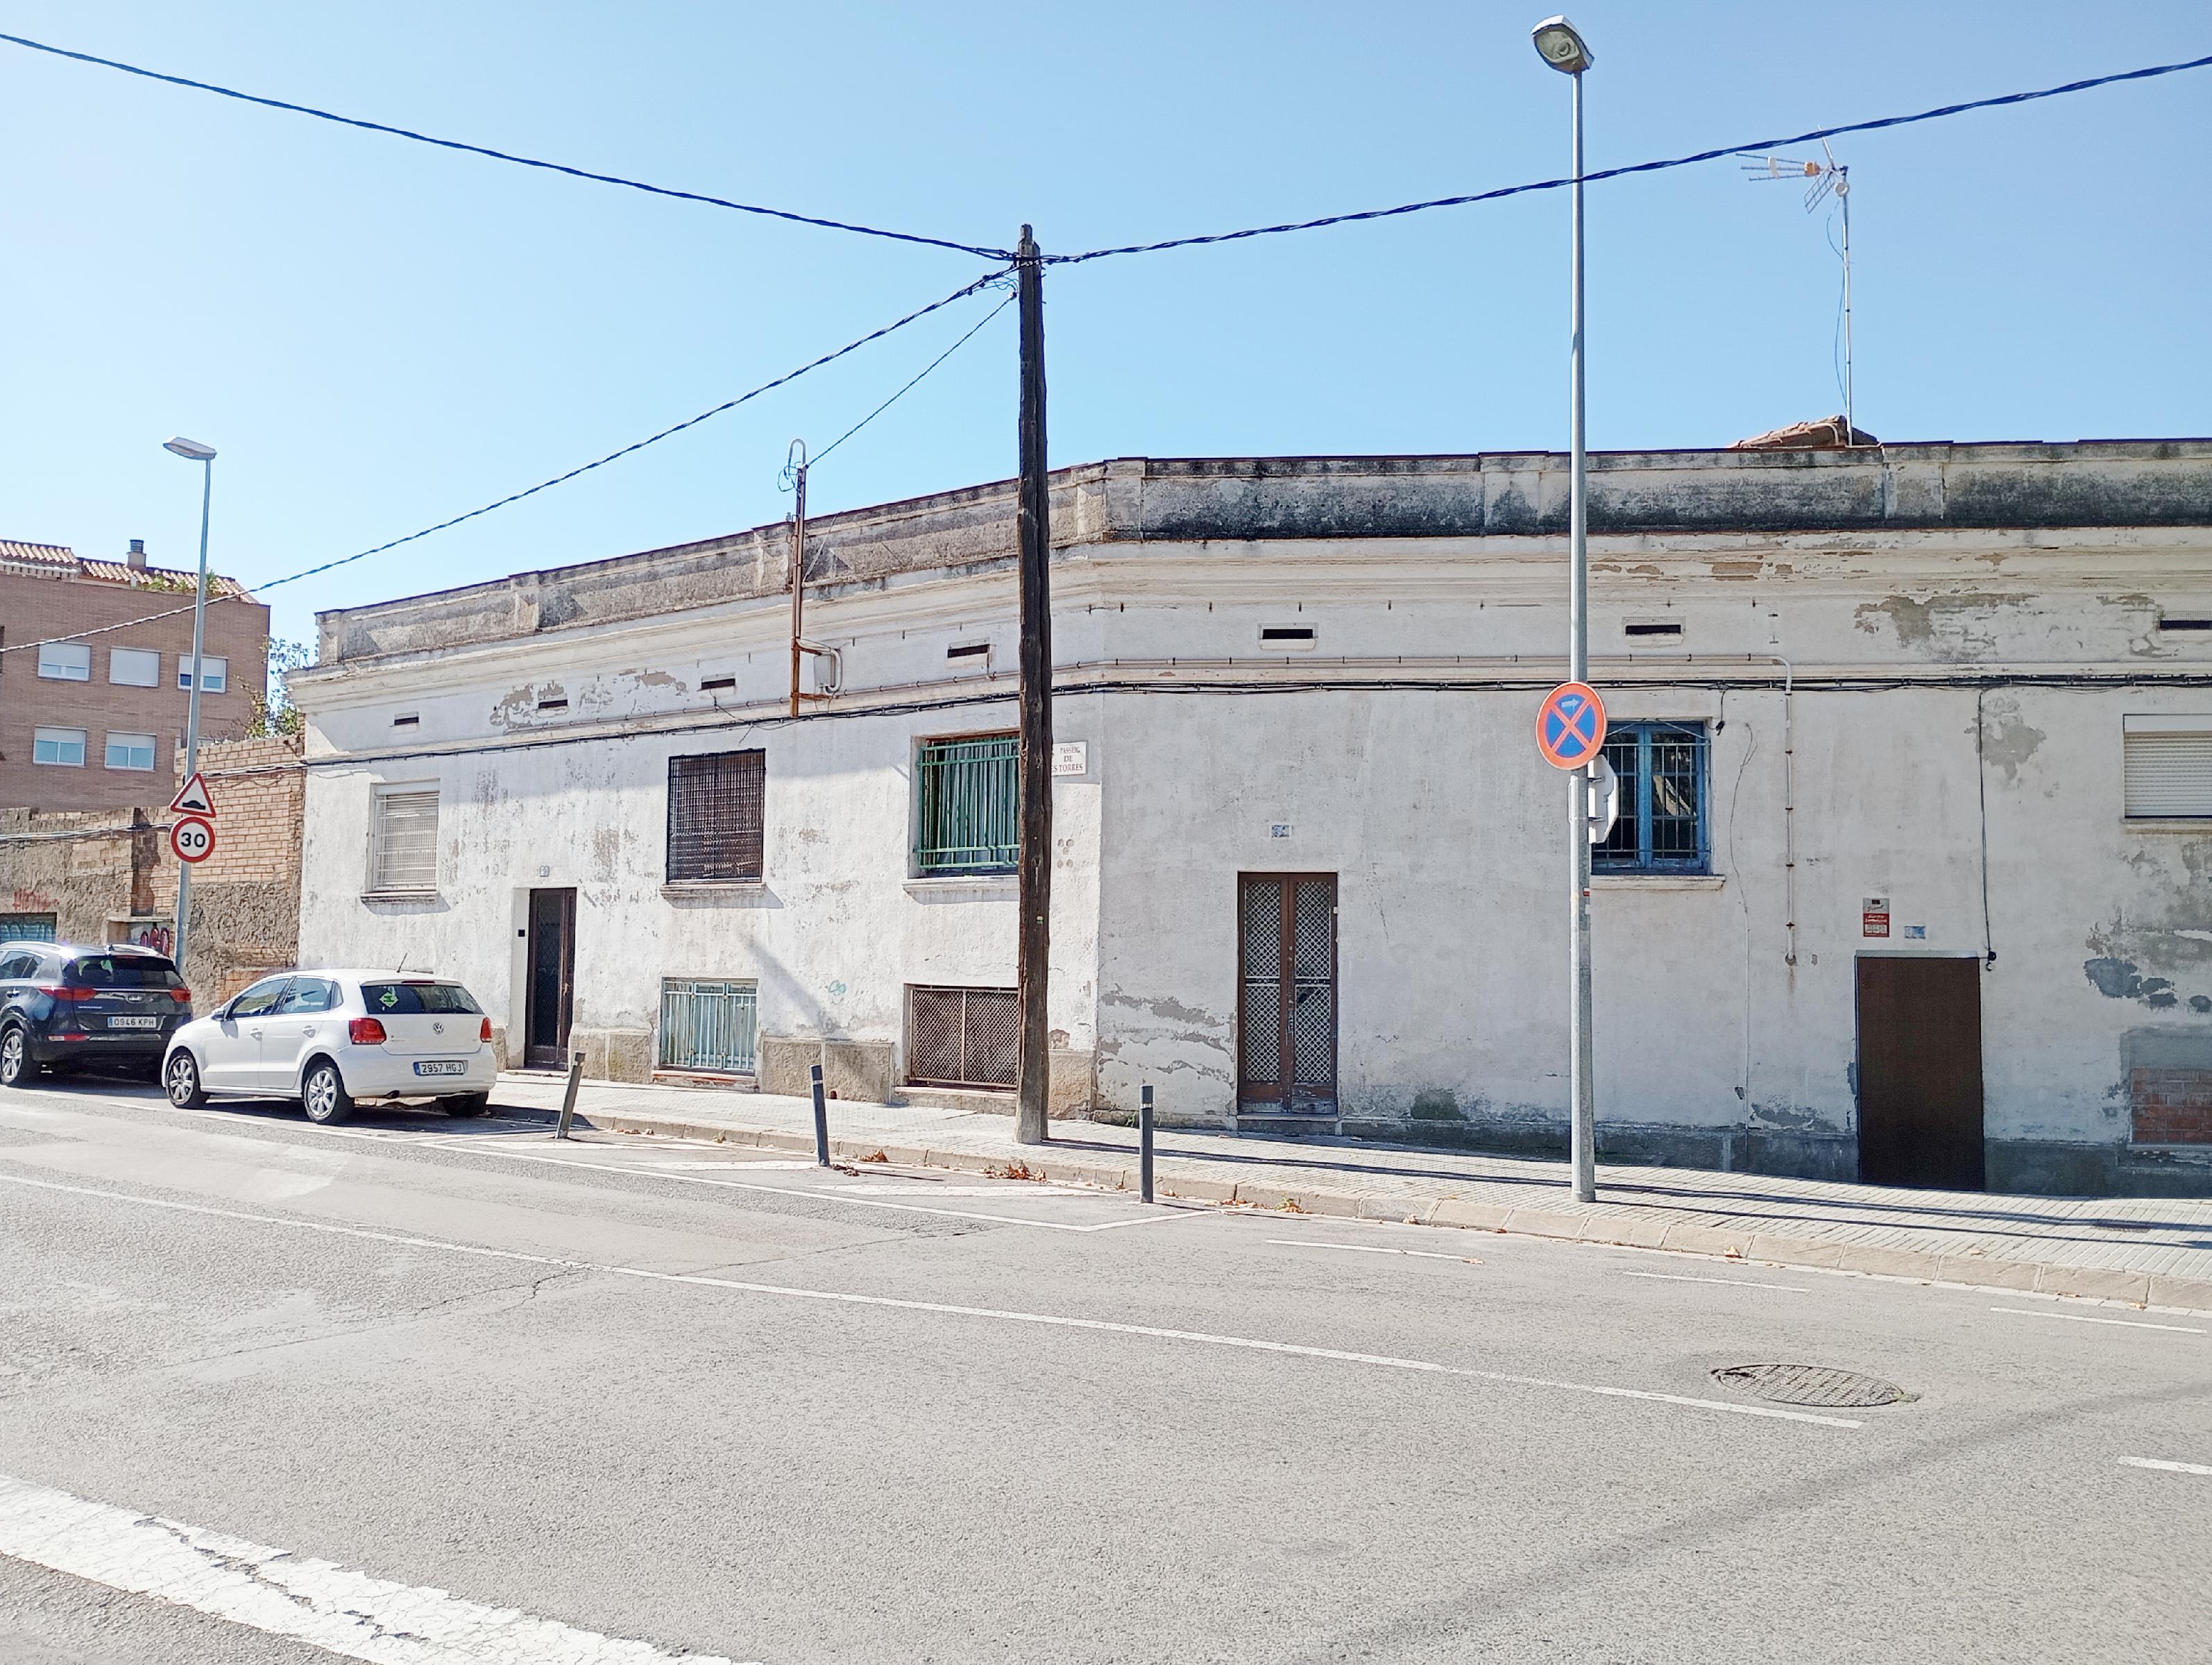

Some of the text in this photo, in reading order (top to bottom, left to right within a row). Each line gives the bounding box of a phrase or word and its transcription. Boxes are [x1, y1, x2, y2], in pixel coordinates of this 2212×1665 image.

[1059, 764, 1083, 772] TORRES
[180, 832, 205, 847] 30
[114, 1018, 154, 1026] 0946 KPH
[421, 1063, 461, 1073] 2957 HGJ
